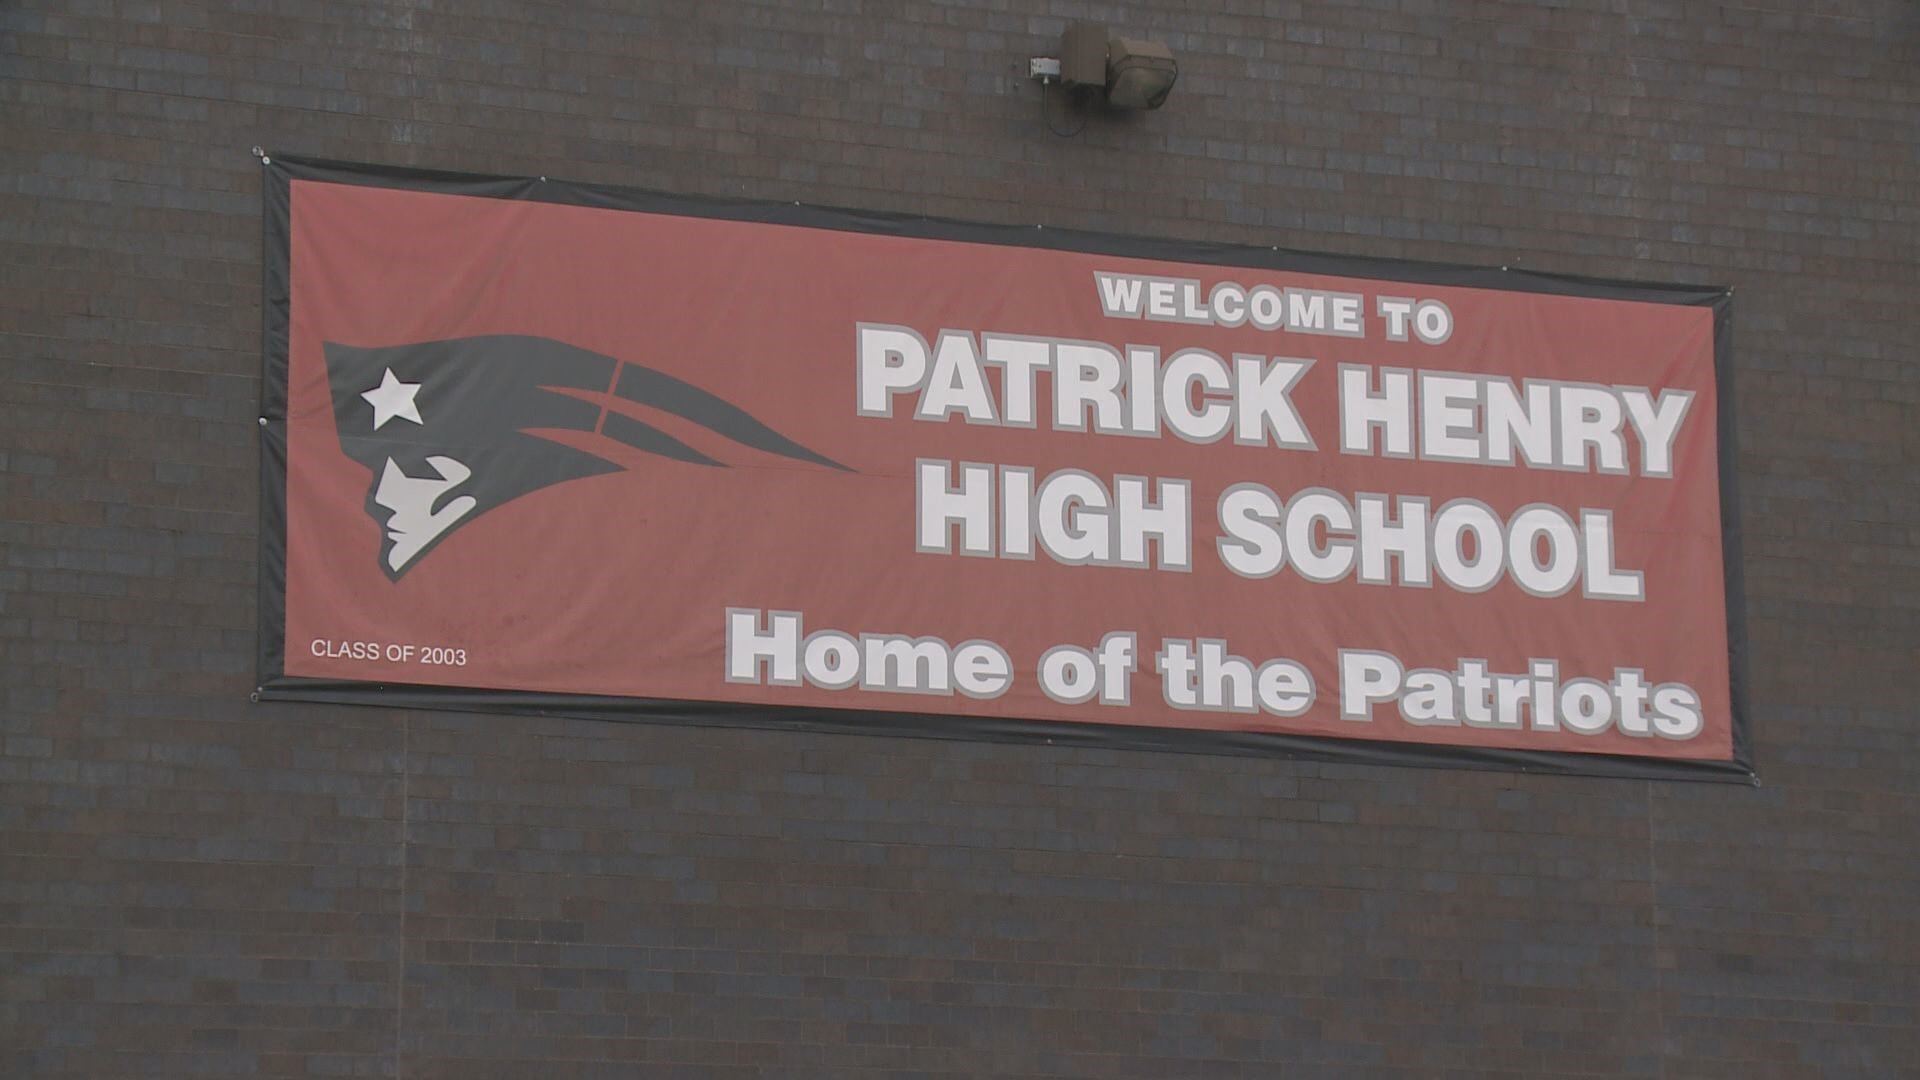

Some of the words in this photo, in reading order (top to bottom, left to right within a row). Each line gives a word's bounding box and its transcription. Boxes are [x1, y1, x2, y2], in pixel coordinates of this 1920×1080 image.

[1094, 271, 1363, 338] WELCOME
[1377, 296, 1453, 345] TO
[856, 322, 1317, 451] PATRICK
[1338, 363, 1695, 478] HENRY
[915, 459, 1192, 572] HIGH
[1217, 483, 1645, 602] SCHOOL
[311, 639, 379, 660] CLASS
[386, 644, 415, 662] OF
[420, 647, 467, 666] 2003
[725, 607, 1012, 700] Home
[1038, 631, 1137, 706] of
[1158, 637, 1315, 717] the
[1338, 649, 1704, 740] Patriots
